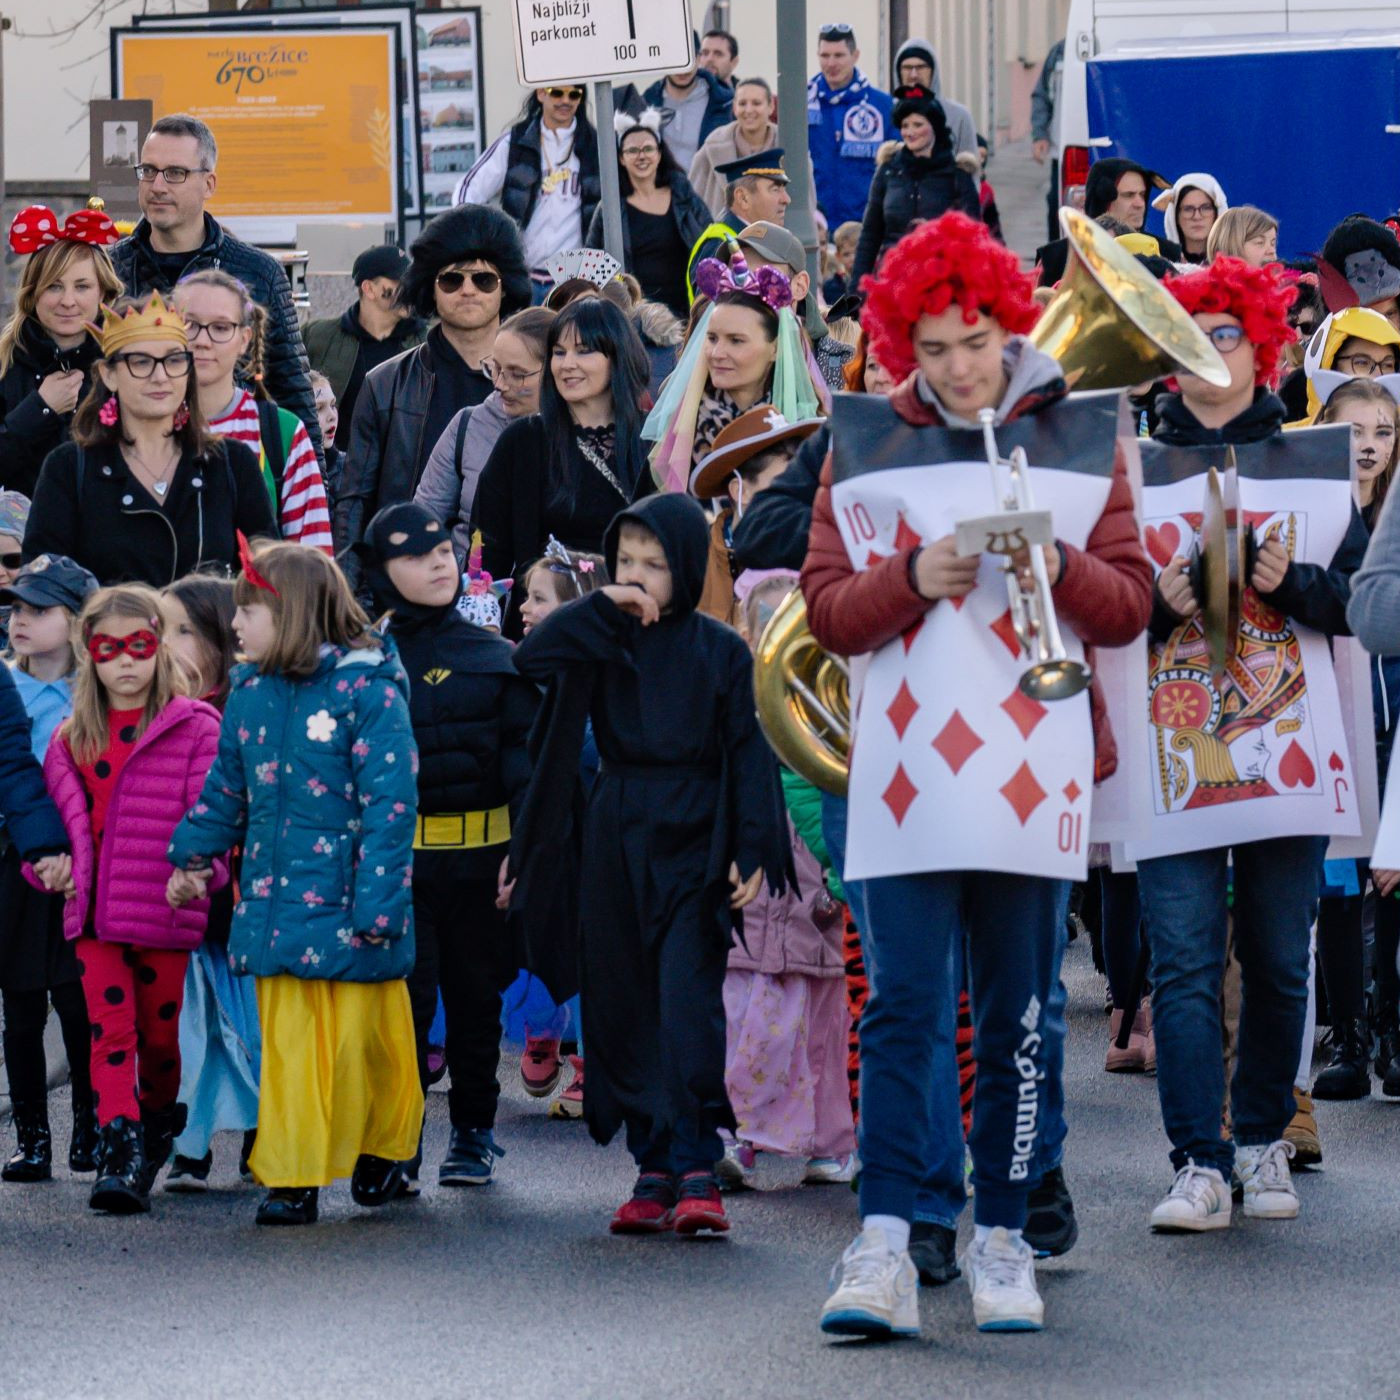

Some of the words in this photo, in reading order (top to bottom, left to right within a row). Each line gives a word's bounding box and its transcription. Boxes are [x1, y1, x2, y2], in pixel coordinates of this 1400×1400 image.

[531, 21, 597, 47] parkomat
[613, 43, 637, 60] 100
[648, 45, 661, 57] m
[843, 502, 877, 545] 10
[1058, 810, 1082, 855] 10
